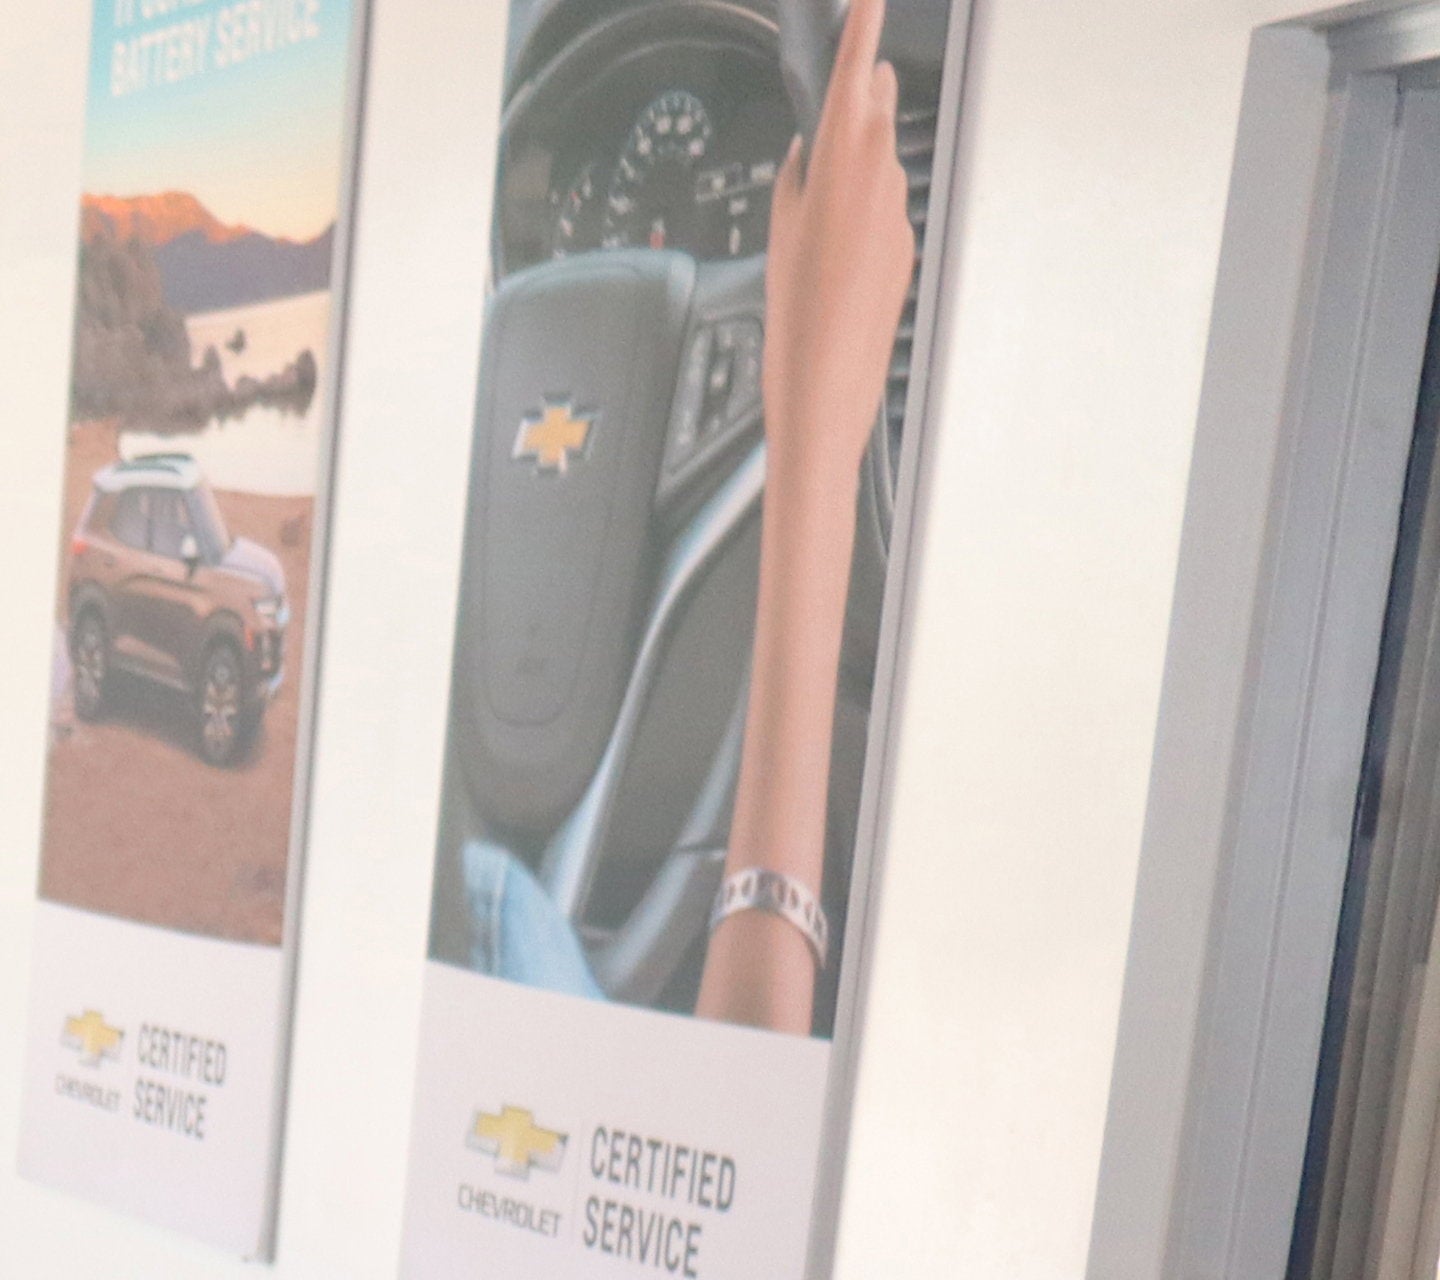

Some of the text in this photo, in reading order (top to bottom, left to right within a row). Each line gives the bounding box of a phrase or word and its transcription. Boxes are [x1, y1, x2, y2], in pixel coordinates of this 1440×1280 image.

[110, 0, 321, 97] BATTERY SERVICE
[136, 1022, 227, 1086] CERTIFIED
[133, 1078, 207, 1141] SERVICE
[590, 1126, 736, 1213] CERTIFIED
[457, 1184, 561, 1238] CHEVROLET
[583, 1195, 702, 1279] SERVICE
